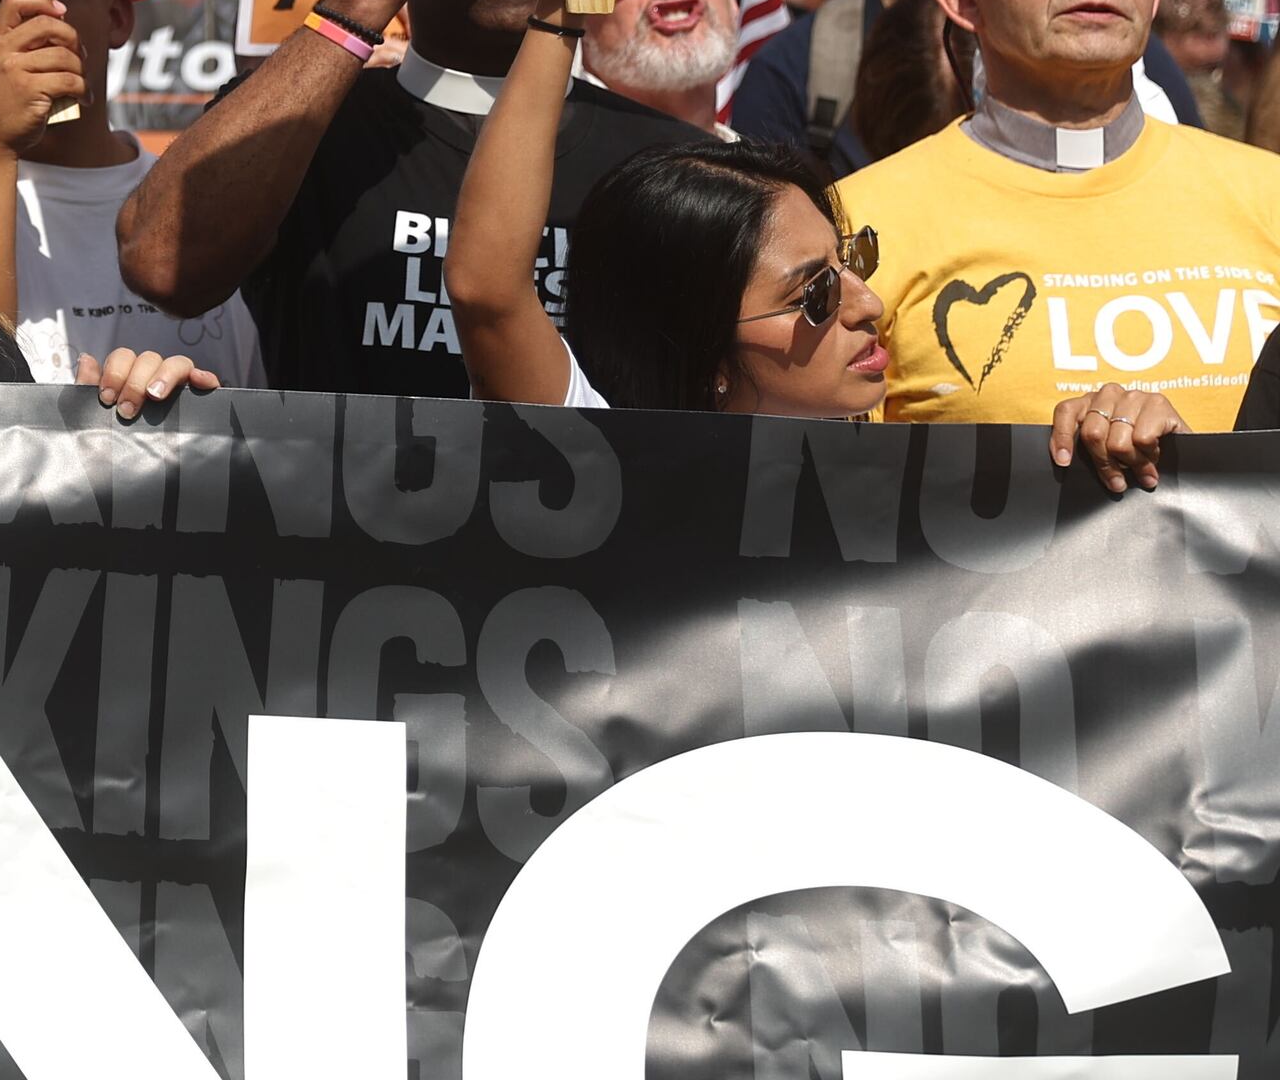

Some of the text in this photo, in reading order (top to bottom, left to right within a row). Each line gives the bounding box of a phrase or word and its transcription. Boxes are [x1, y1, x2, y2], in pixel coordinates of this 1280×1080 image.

[1043, 272, 1138, 288] STANDING
[1143, 268, 1171, 284] ON
[1176, 266, 1210, 280] THE
[1046, 288, 1280, 372] LOVE
